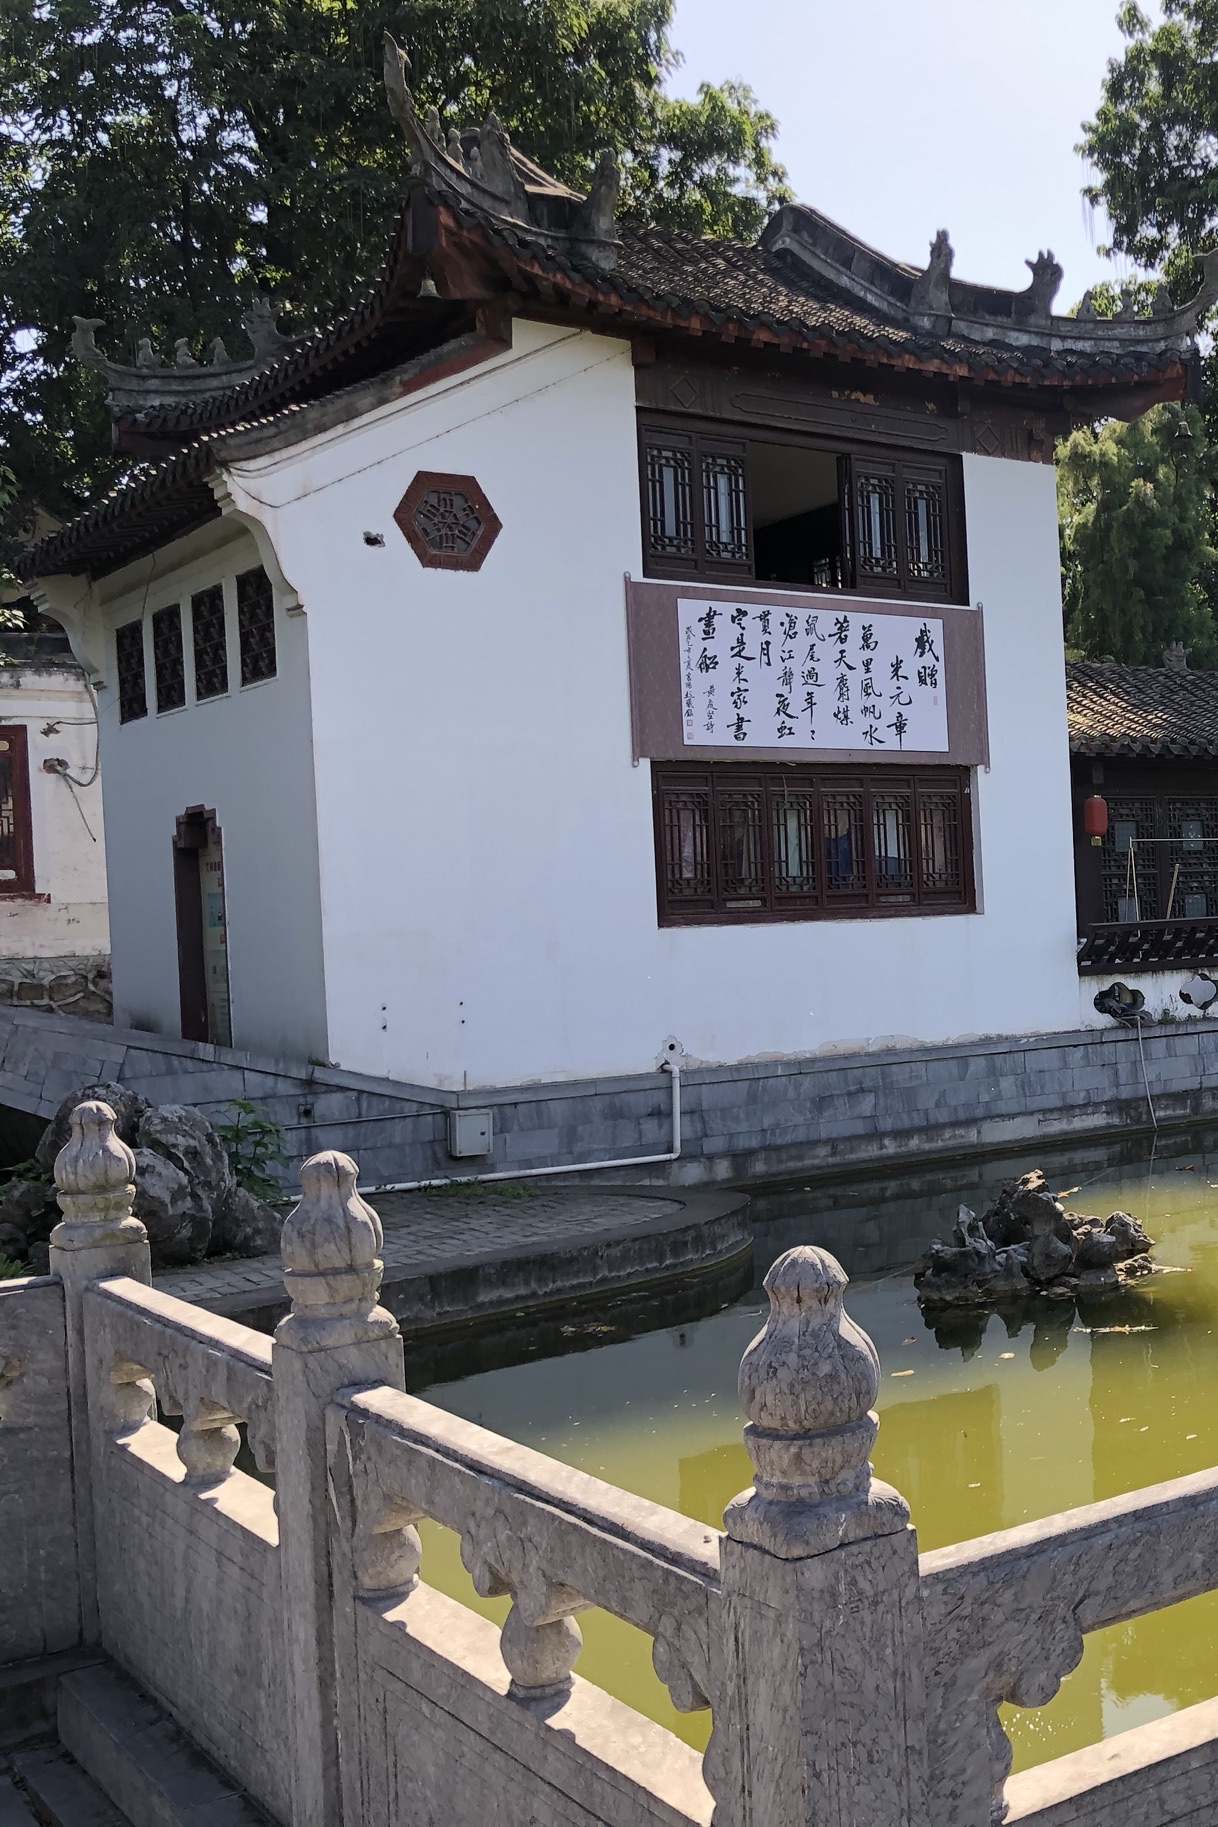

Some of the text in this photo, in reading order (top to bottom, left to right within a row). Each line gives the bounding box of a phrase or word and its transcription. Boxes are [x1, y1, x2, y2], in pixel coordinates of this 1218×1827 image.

[726, 608, 756, 741] 定是米家書
[752, 610, 773, 669] 貫月
[859, 623, 886, 746] 萬里風帆水
[887, 655, 912, 750] 米元章
